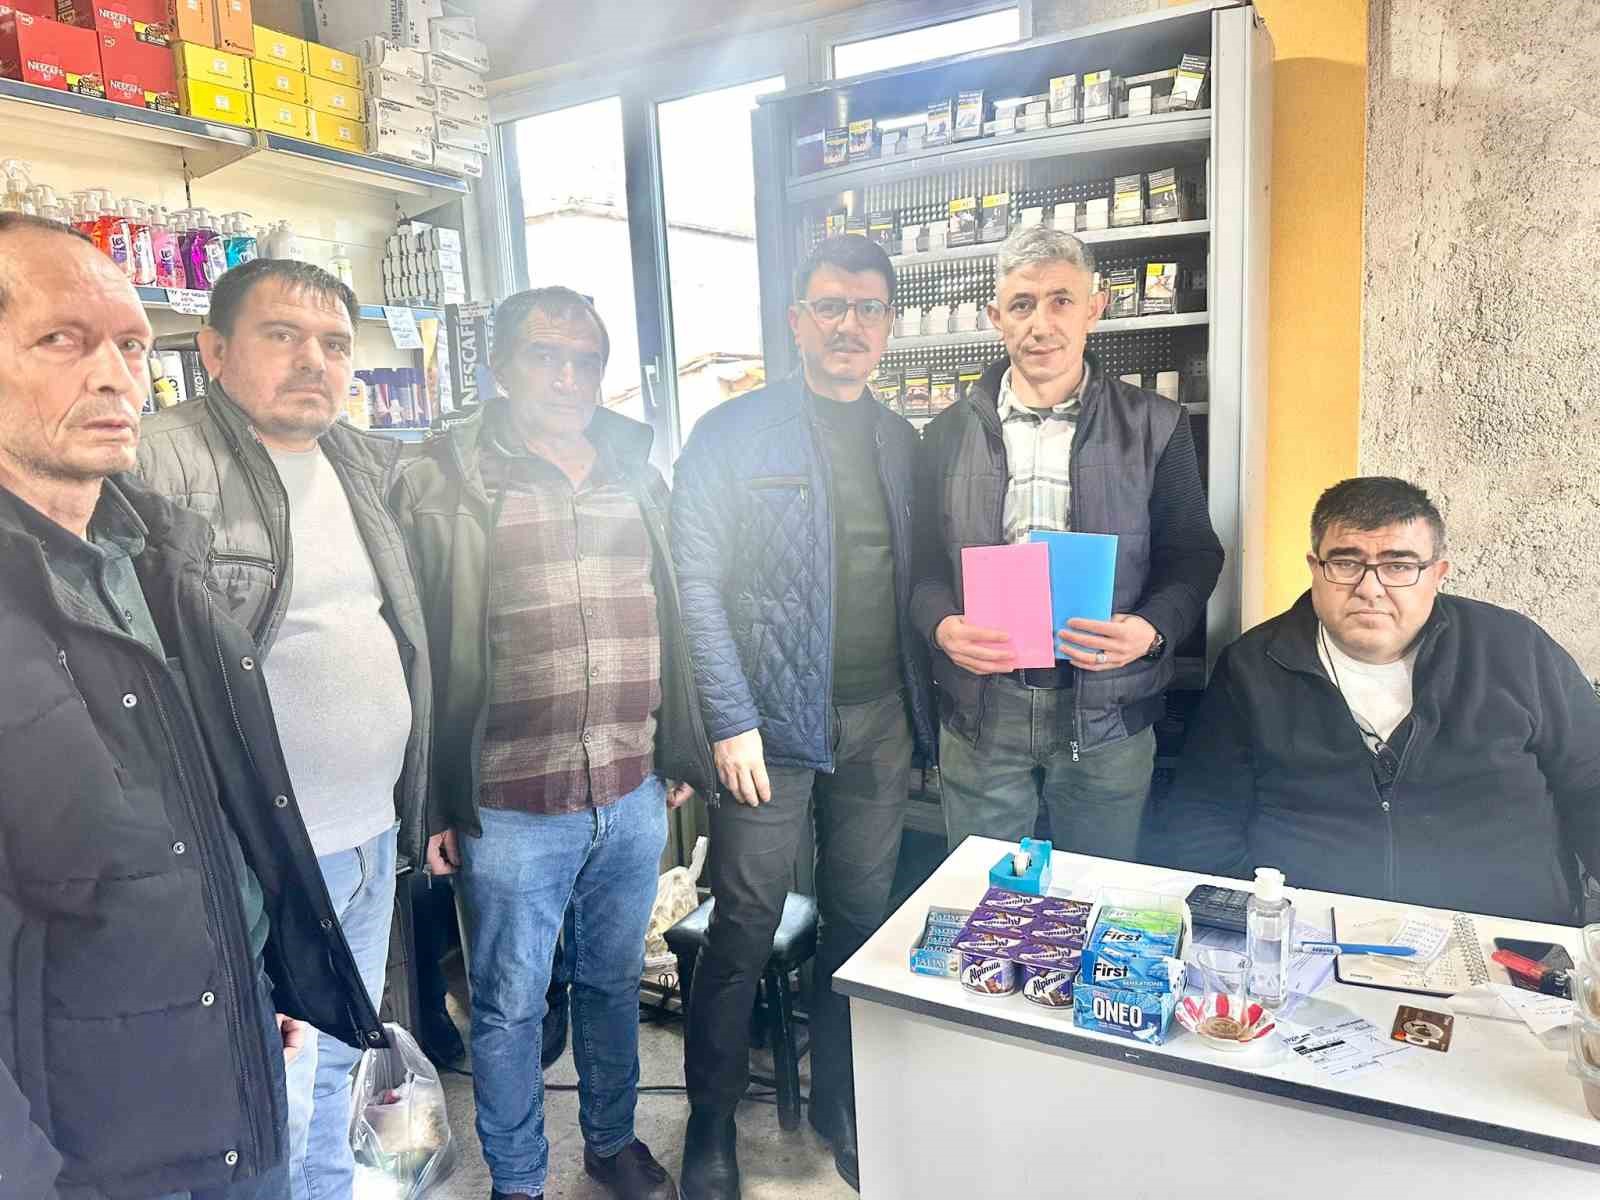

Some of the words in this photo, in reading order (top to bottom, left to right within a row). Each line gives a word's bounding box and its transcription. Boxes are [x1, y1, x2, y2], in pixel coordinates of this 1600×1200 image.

[1102, 929, 1142, 942] First
[1093, 962, 1128, 977] First
[1093, 997, 1142, 1028] ONEO
